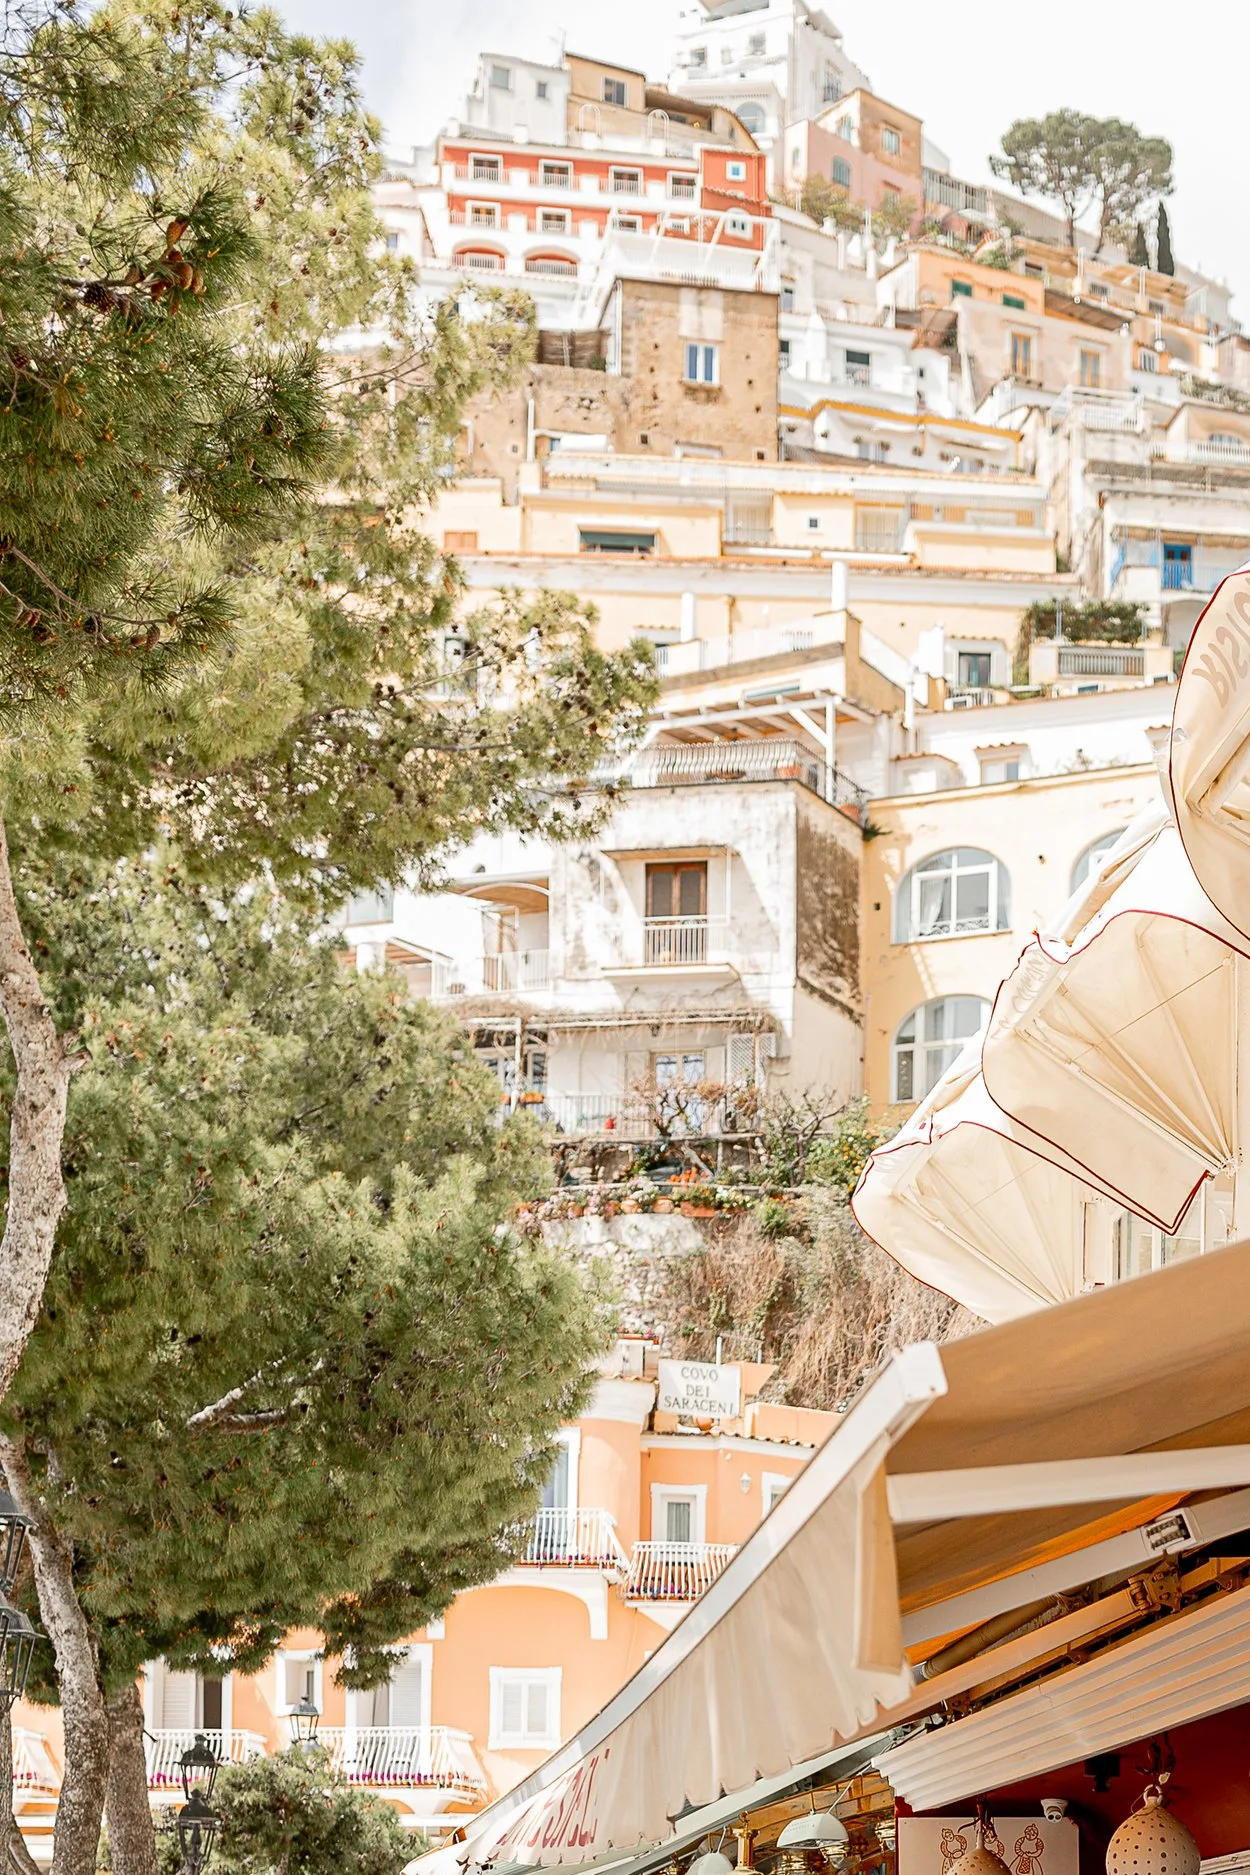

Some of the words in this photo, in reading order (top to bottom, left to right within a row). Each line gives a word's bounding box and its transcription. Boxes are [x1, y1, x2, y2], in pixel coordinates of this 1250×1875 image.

[681, 1367, 718, 1381] COVO
[686, 1384, 710, 1398] DEI
[664, 1396, 734, 1414] SARACENI
